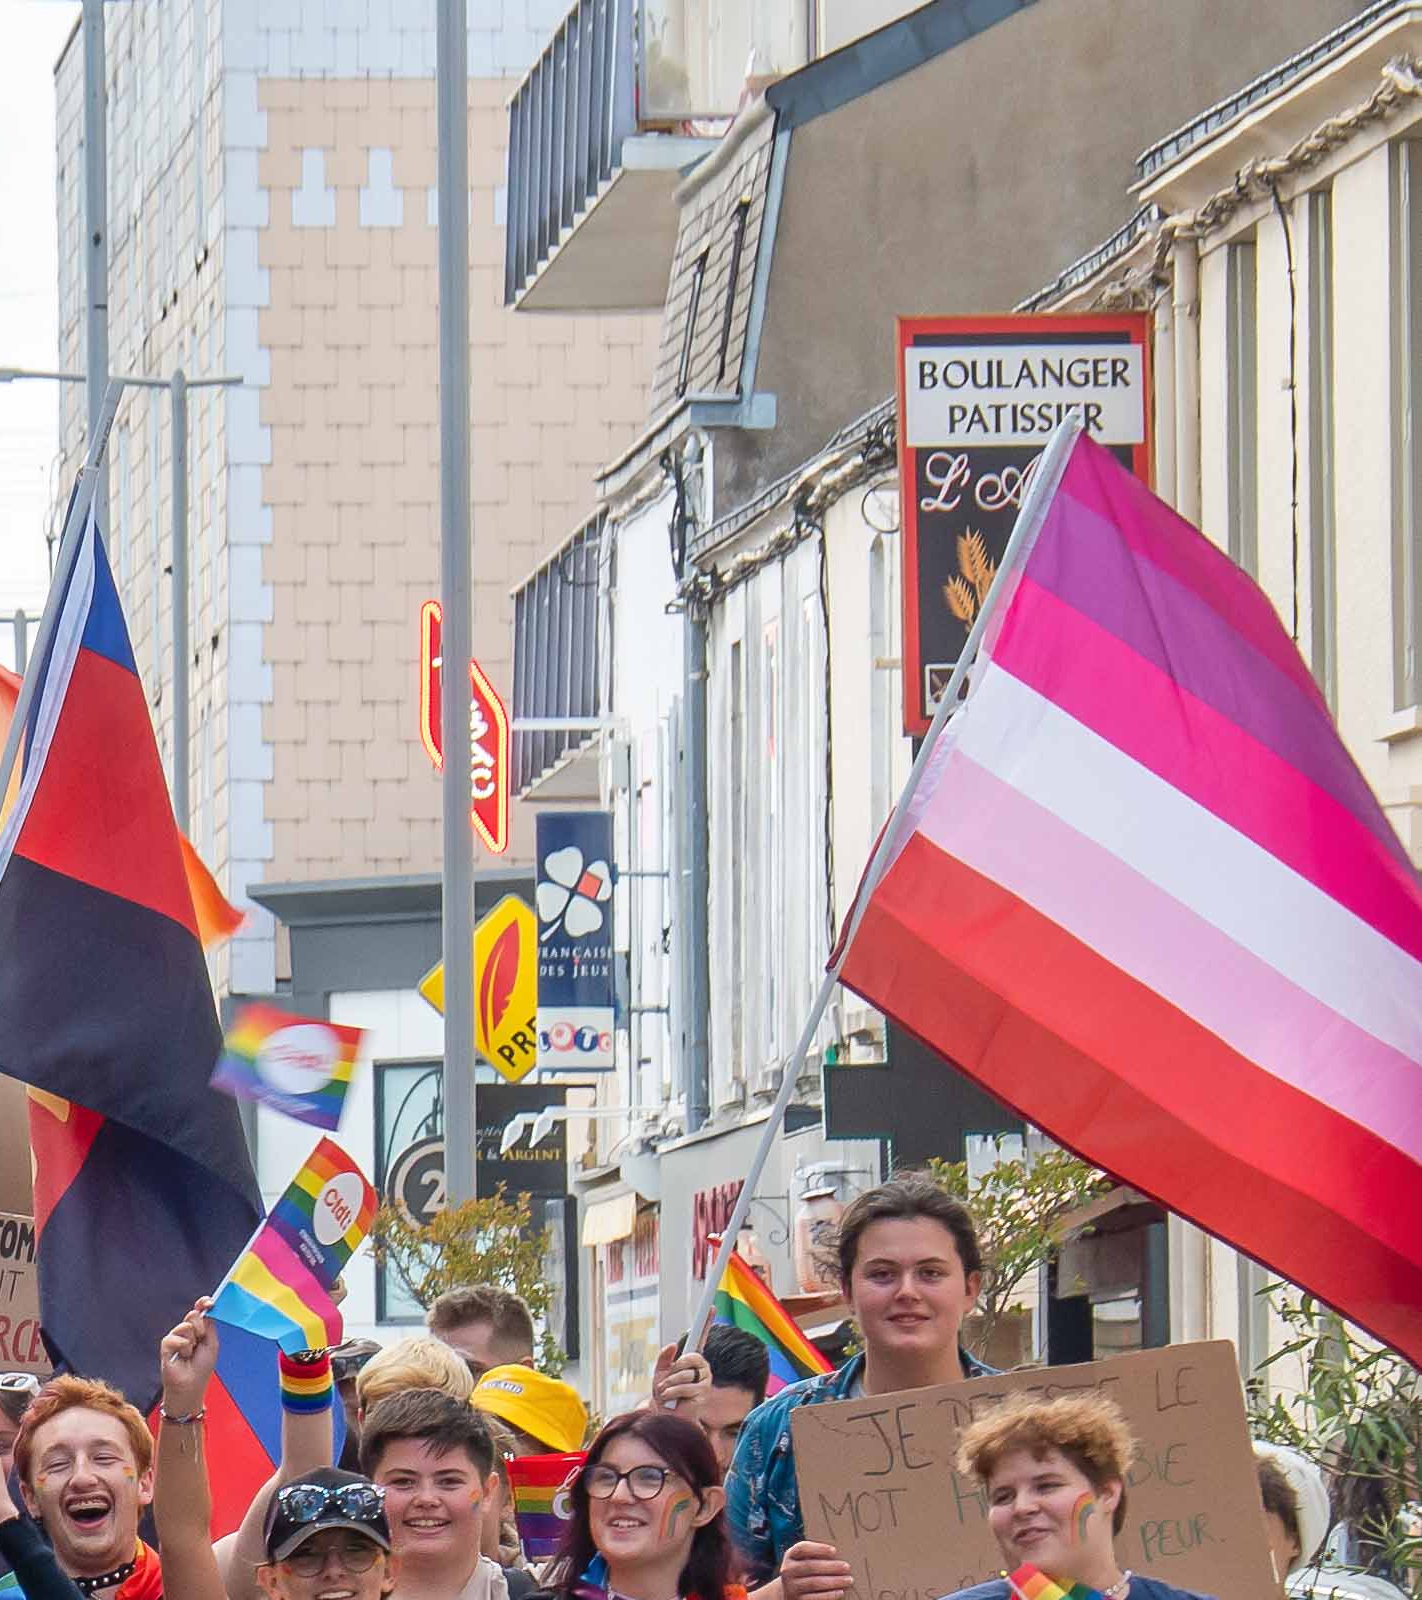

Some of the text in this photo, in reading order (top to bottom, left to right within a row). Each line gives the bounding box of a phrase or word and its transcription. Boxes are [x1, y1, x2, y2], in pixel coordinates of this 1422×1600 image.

[918, 357, 1131, 389] BOULANGER
[539, 964, 566, 978] DES
[420, 1169, 446, 1214] 2
[847, 1403, 932, 1476] JE
[1153, 1367, 1199, 1412] LE
[818, 1487, 908, 1541] MOT
